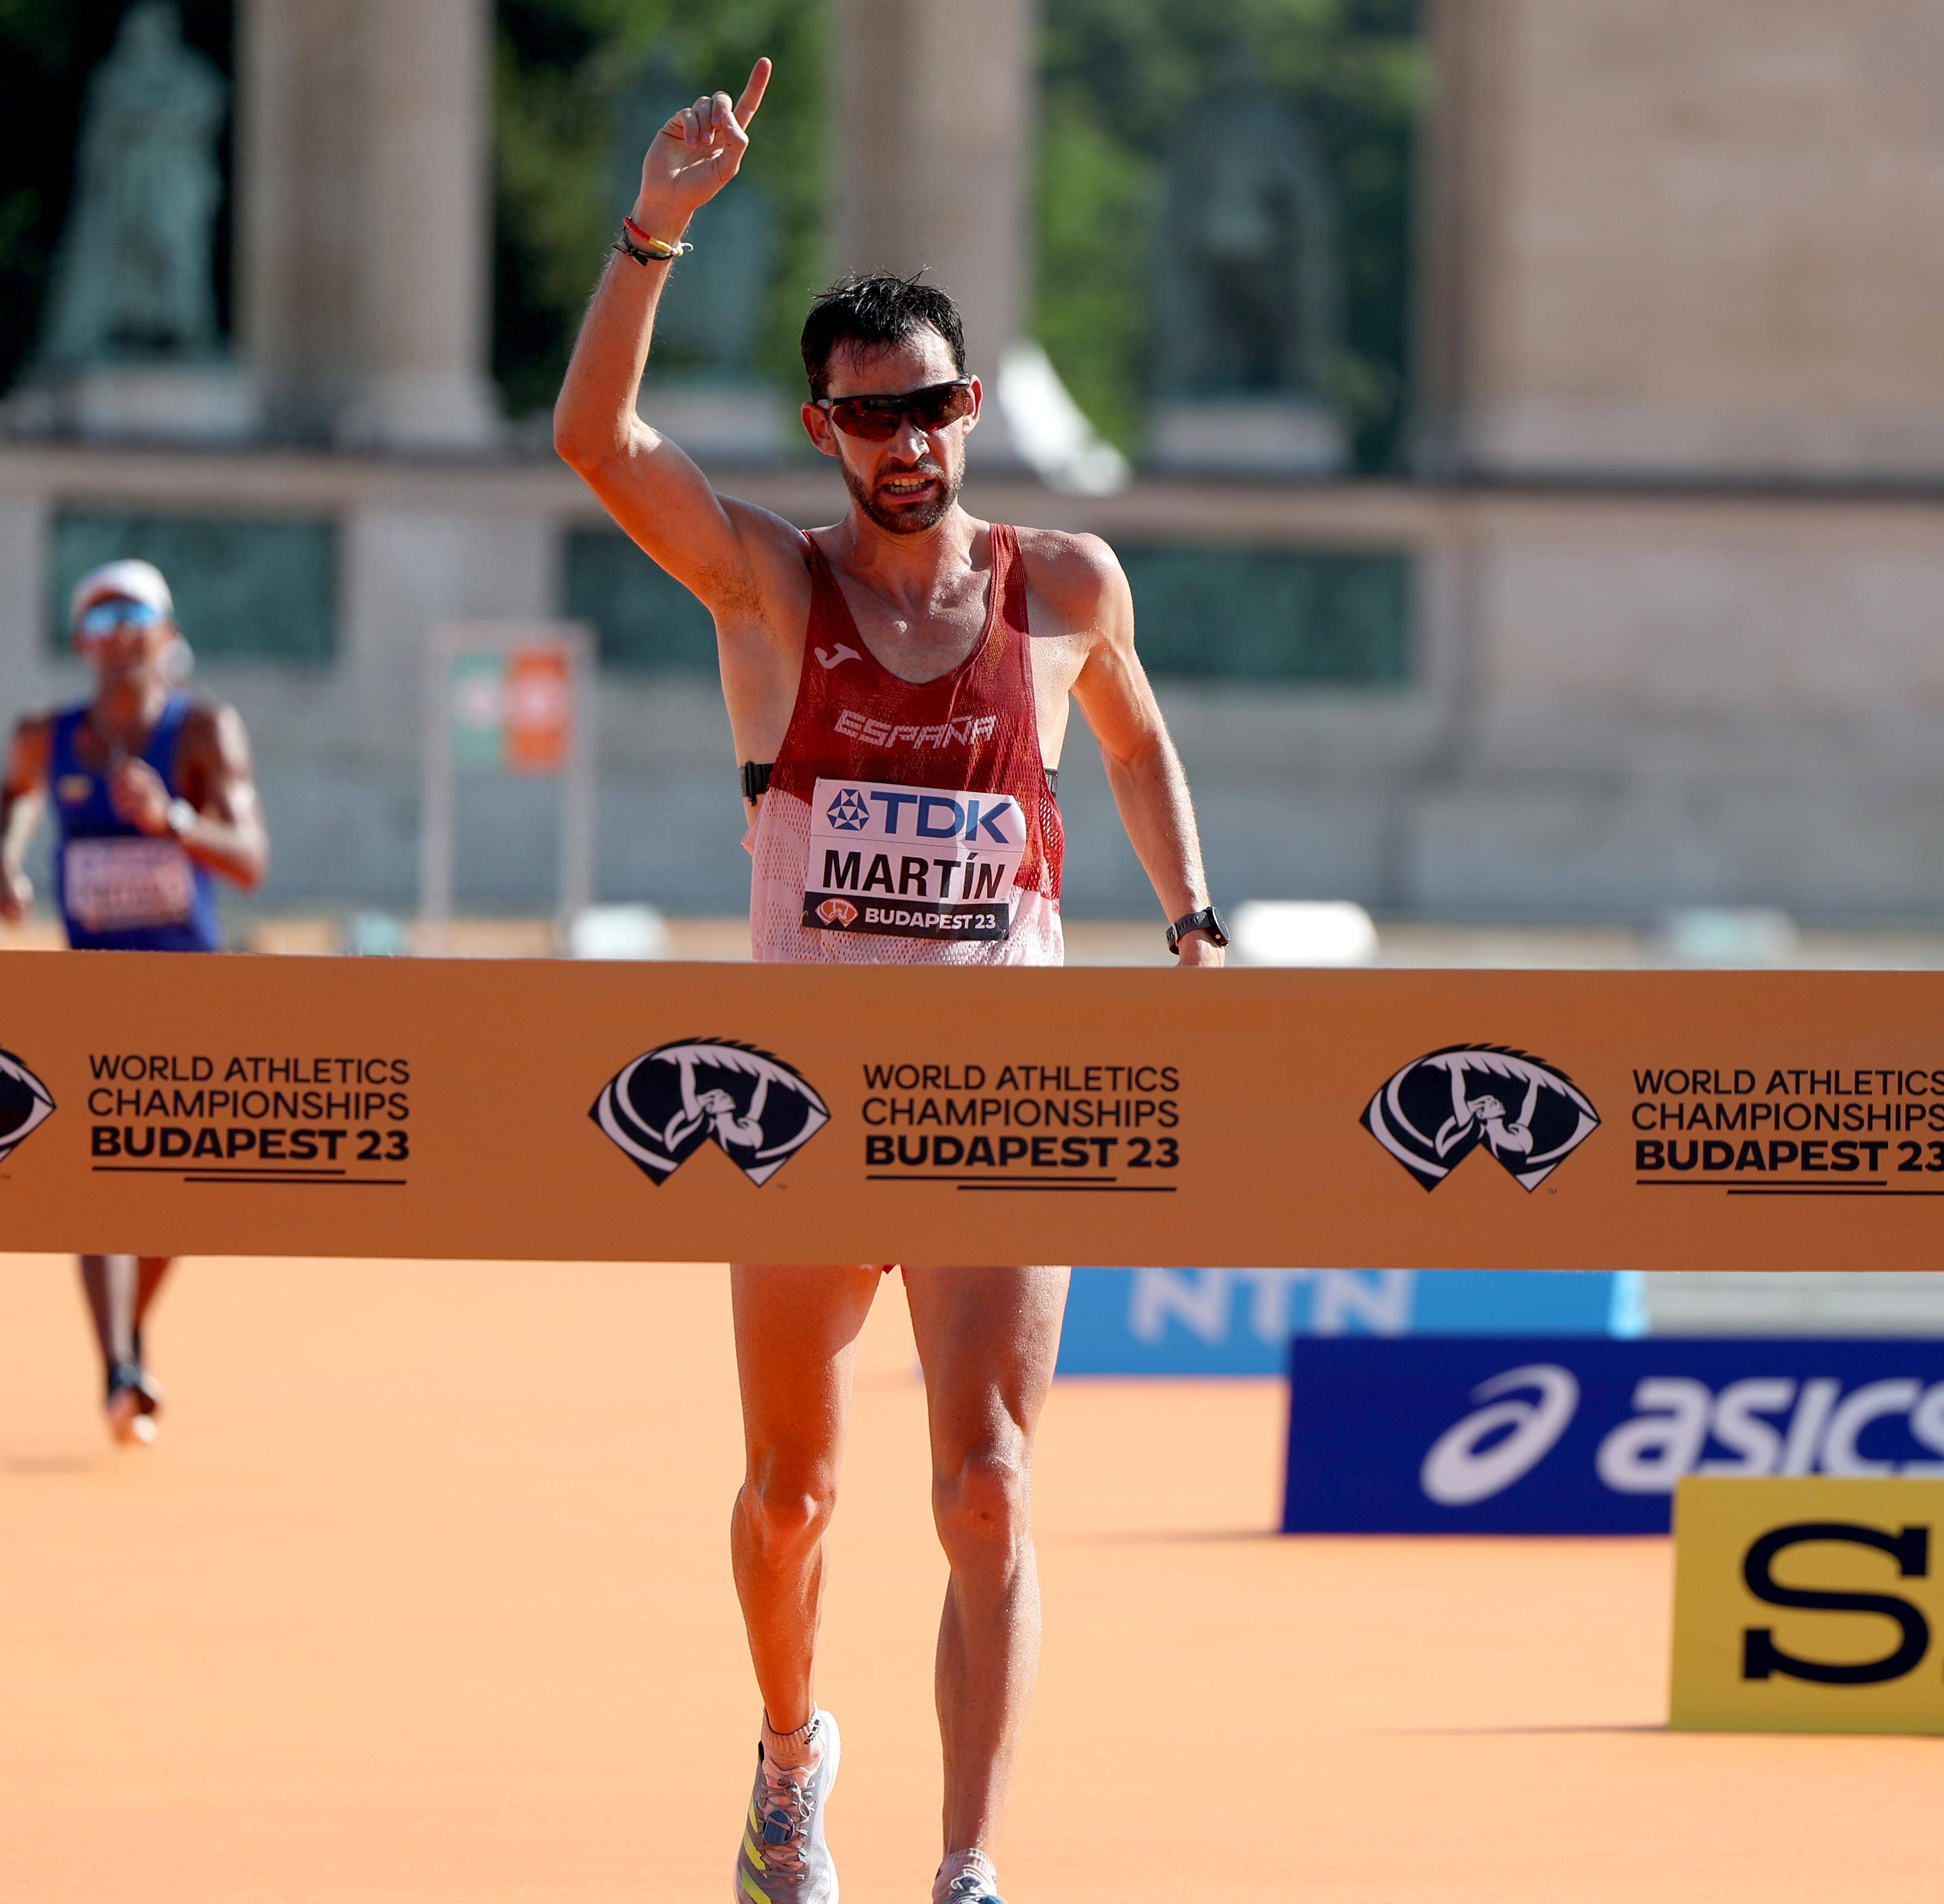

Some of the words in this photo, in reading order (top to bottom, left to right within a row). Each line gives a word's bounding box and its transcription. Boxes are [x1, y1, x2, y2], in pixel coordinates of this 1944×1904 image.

[834, 709, 997, 749] ESPAÑA
[870, 790, 1013, 844] TDK
[823, 849, 1006, 900] MARTÍN
[865, 908, 973, 930] BUDAPEST
[974, 914, 996, 930] 23
[89, 1054, 214, 1082] WORLD
[223, 1057, 410, 1085] ATHLETICS
[863, 1064, 986, 1090] WORLD
[995, 1065, 1180, 1093] ATHLETICS
[1632, 1068, 1756, 1095] WORLD
[1765, 1069, 1944, 1097] ATHLETICS
[87, 1088, 410, 1121] CHAMPIONSHIPS
[861, 1097, 1179, 1129] CHAMPIONSHIPS
[1631, 1101, 1944, 1133] CHAMPIONSHIPS
[91, 1125, 348, 1160] BUDAPEST
[356, 1129, 410, 1161] 23
[865, 1134, 1119, 1168] BUDAPEST
[1126, 1136, 1180, 1169] 23
[1635, 1139, 1889, 1172] BUDAPEST
[1897, 1139, 1944, 1173] 23
[1129, 1268, 1416, 1344] NTN
